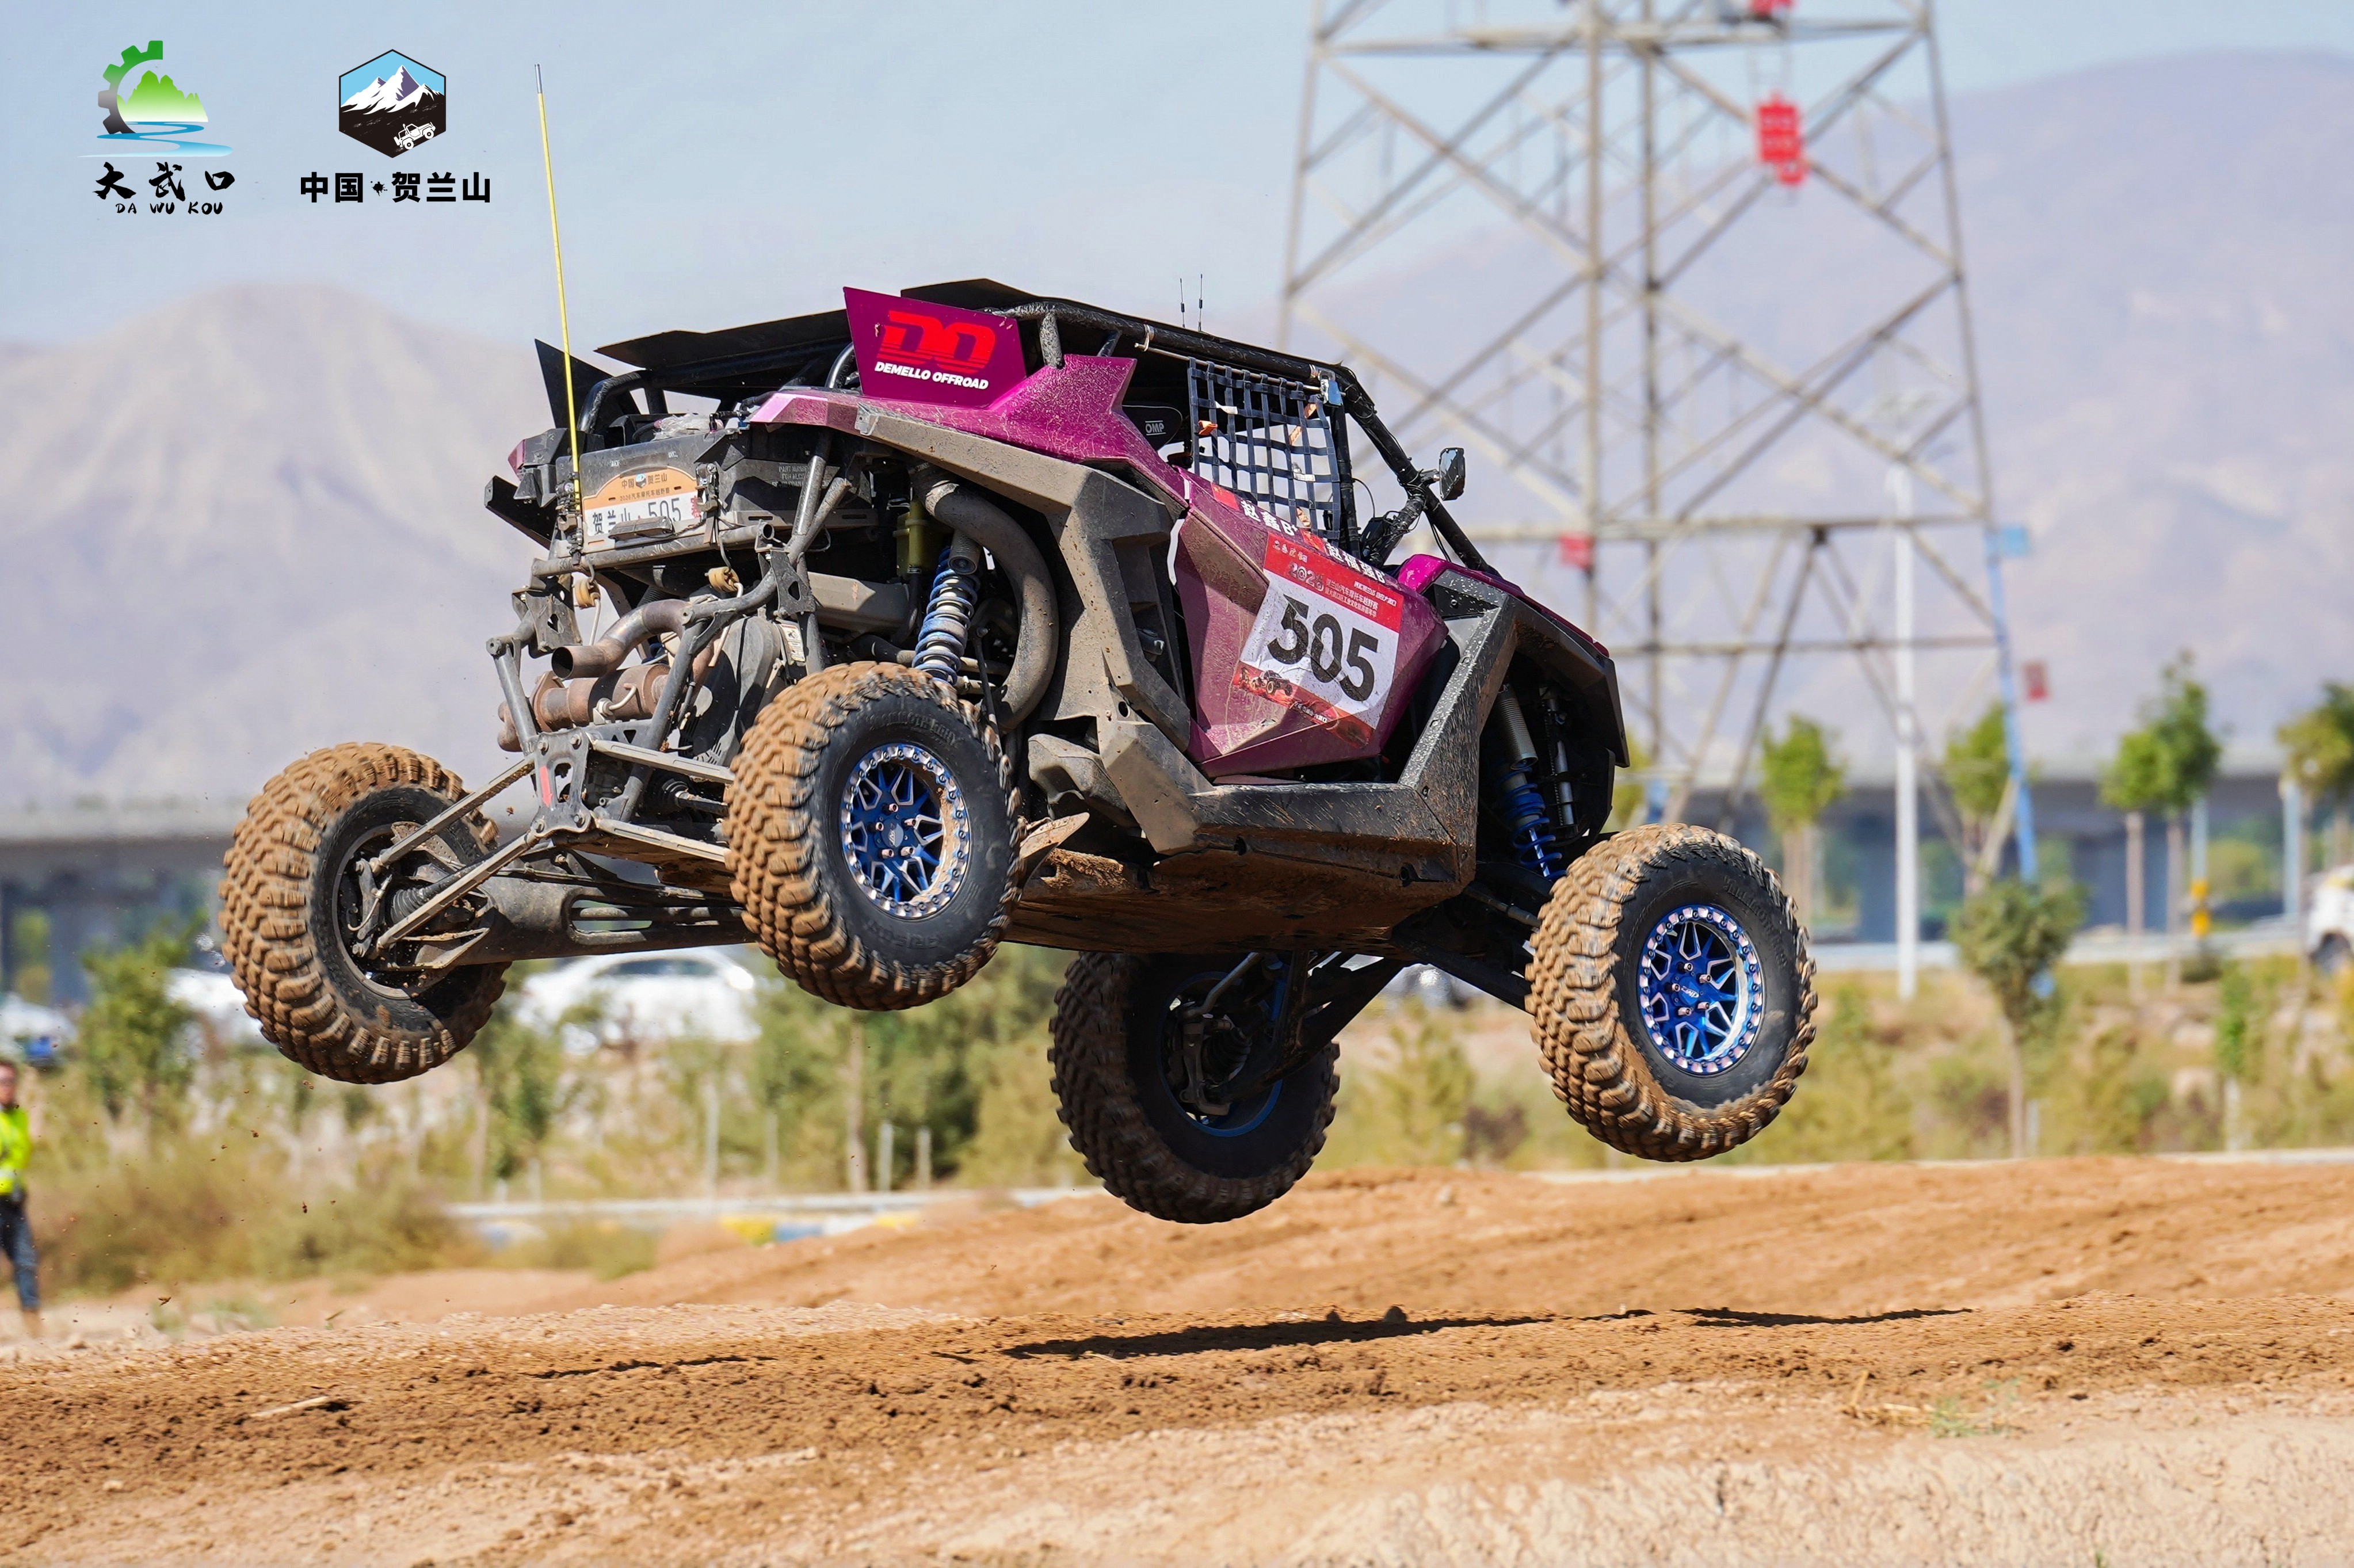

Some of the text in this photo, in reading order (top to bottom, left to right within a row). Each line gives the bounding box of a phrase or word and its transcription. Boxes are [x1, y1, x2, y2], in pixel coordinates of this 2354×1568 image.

[875, 361, 989, 390] DEMELLO OFFROAD
[1145, 422, 1165, 433] OMP
[648, 497, 681, 522] 505
[1268, 594, 1379, 701] 505
